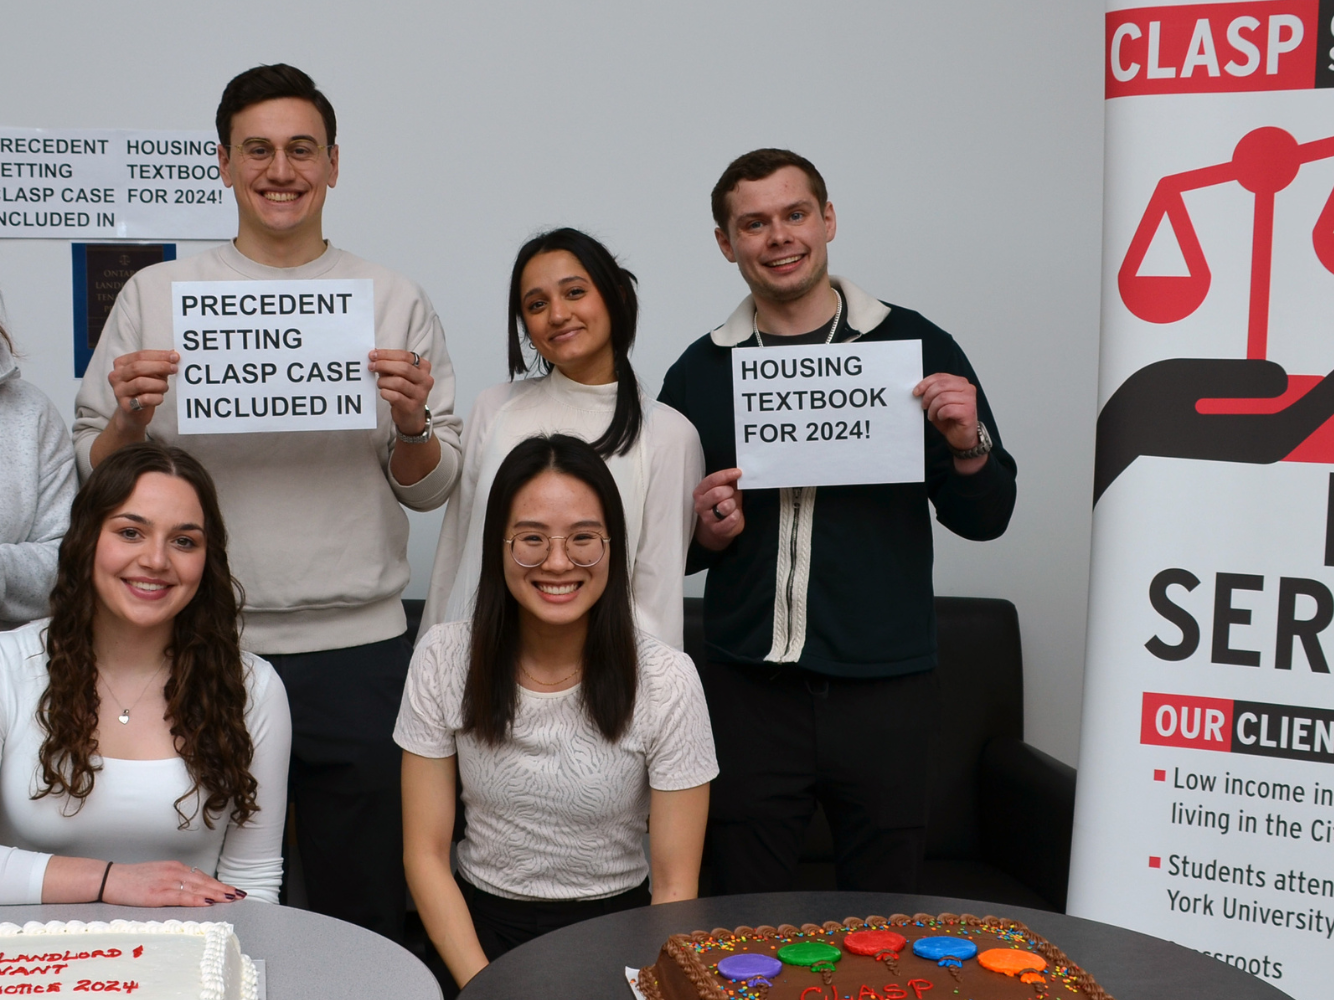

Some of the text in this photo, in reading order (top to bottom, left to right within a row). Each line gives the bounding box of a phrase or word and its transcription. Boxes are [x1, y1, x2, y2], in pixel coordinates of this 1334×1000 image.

[1110, 14, 1305, 82] CLASP
[127, 139, 217, 156] HOUSING
[126, 164, 221, 180] TEXTBOO
[61, 187, 115, 204] CASE
[128, 188, 223, 205] FOR 2024!
[97, 212, 115, 228] IN
[182, 293, 353, 316] PRECEDENT
[182, 328, 302, 351] SETTING
[184, 361, 362, 385] CLASP CASE
[741, 355, 863, 380] HOUSING
[186, 394, 362, 419] INCLUDED IN
[741, 387, 888, 412] TEXTBOOK
[744, 420, 871, 443] FOR 2024!
[1155, 704, 1226, 742] OUR
[1174, 767, 1217, 793] Low
[1224, 772, 1306, 803] income
[1171, 802, 1230, 835] living
[1238, 809, 1257, 833] in
[1265, 813, 1303, 839] the
[1168, 854, 1267, 888] Students
[1167, 889, 1215, 917] York
[73, 979, 139, 994] 2024
